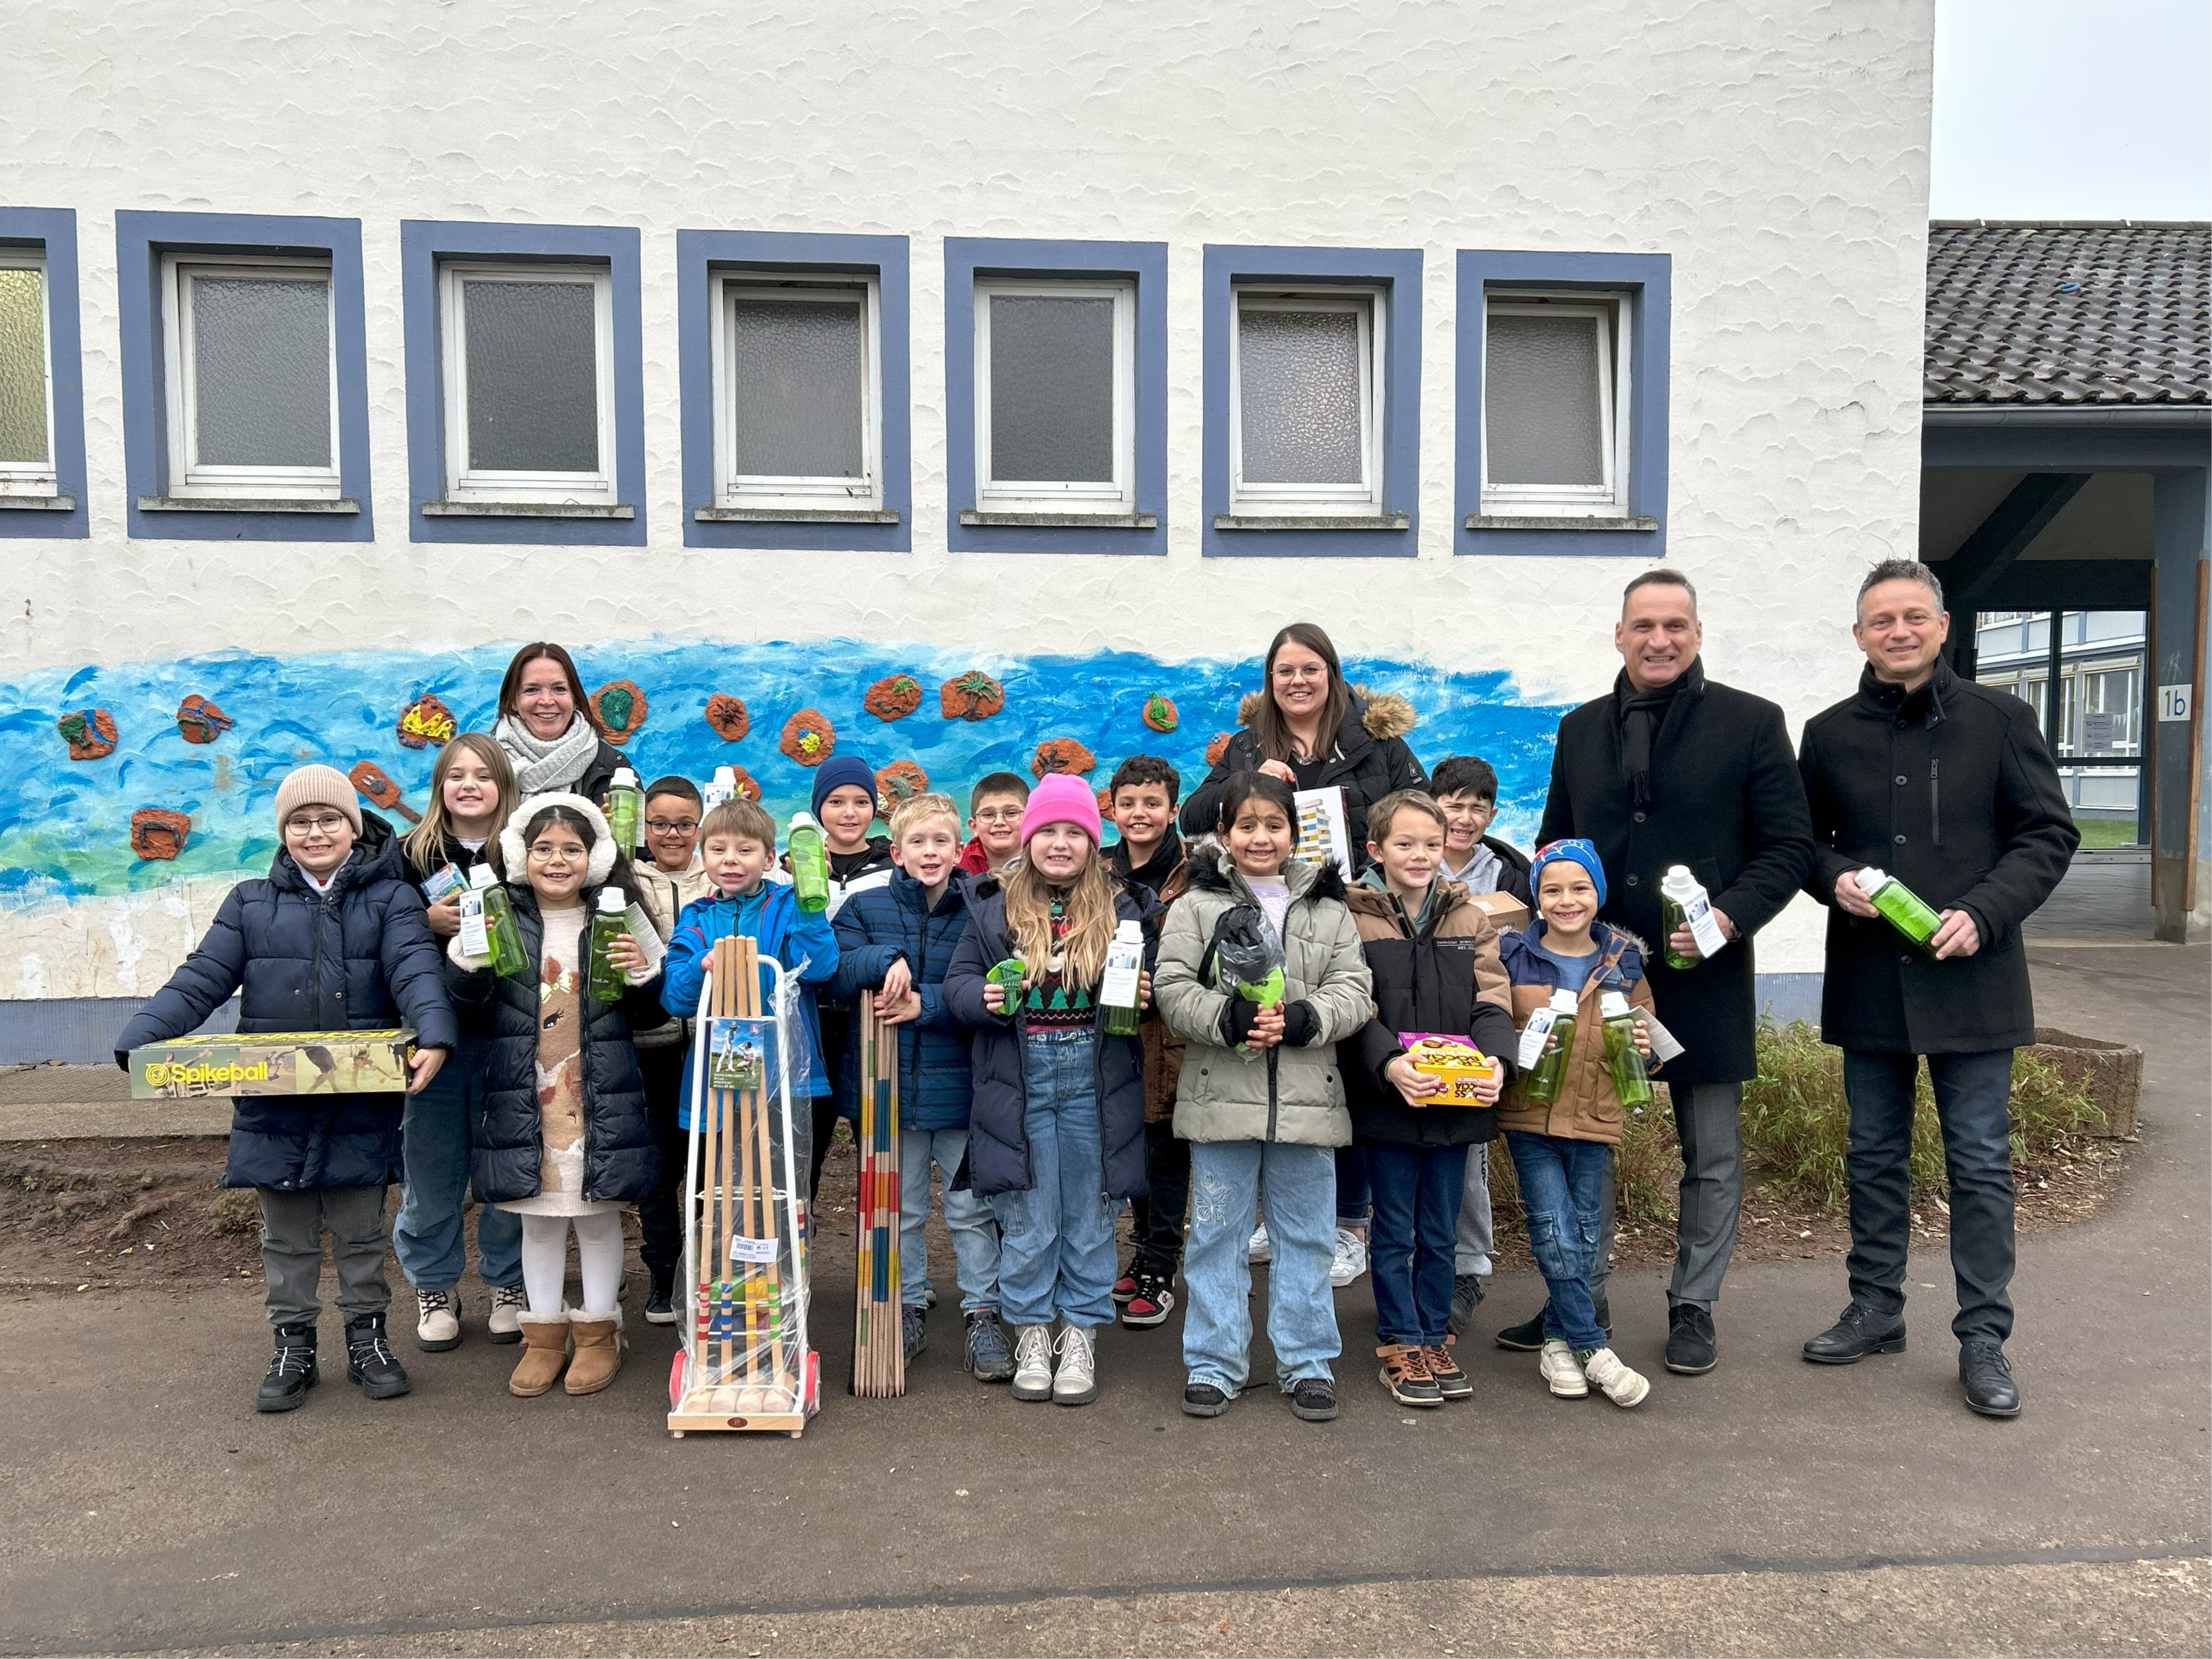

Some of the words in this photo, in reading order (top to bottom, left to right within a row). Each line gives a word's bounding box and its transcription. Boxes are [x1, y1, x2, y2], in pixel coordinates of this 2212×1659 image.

[2165, 690, 2186, 716] 1b
[212, 1031, 400, 1042] Spikeball
[171, 1062, 268, 1084] Spikeball
